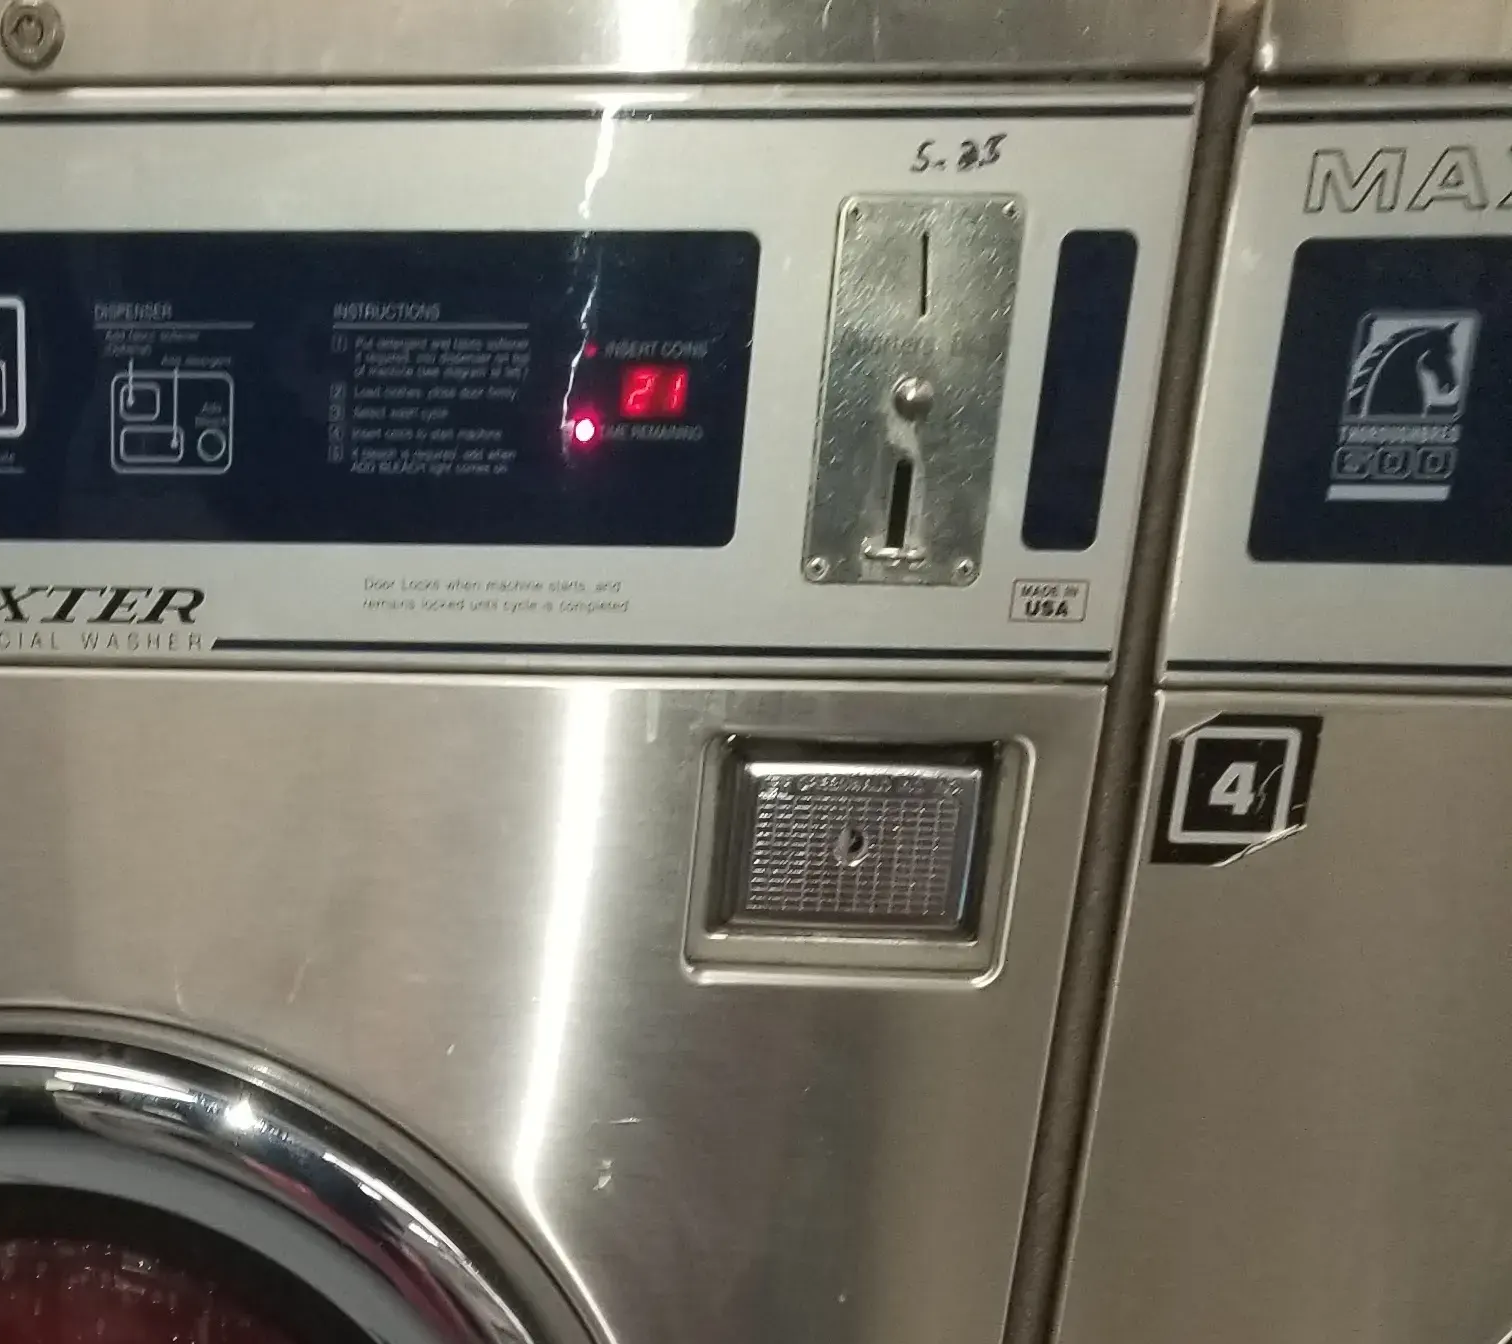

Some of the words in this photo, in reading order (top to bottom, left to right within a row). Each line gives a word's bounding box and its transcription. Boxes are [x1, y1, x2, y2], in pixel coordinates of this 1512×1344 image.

[1302, 146, 1512, 214] MA
[625, 366, 687, 414] 21
[1024, 599, 1069, 617] USA
[80, 629, 204, 652] WASHER
[1207, 760, 1259, 816] 4
